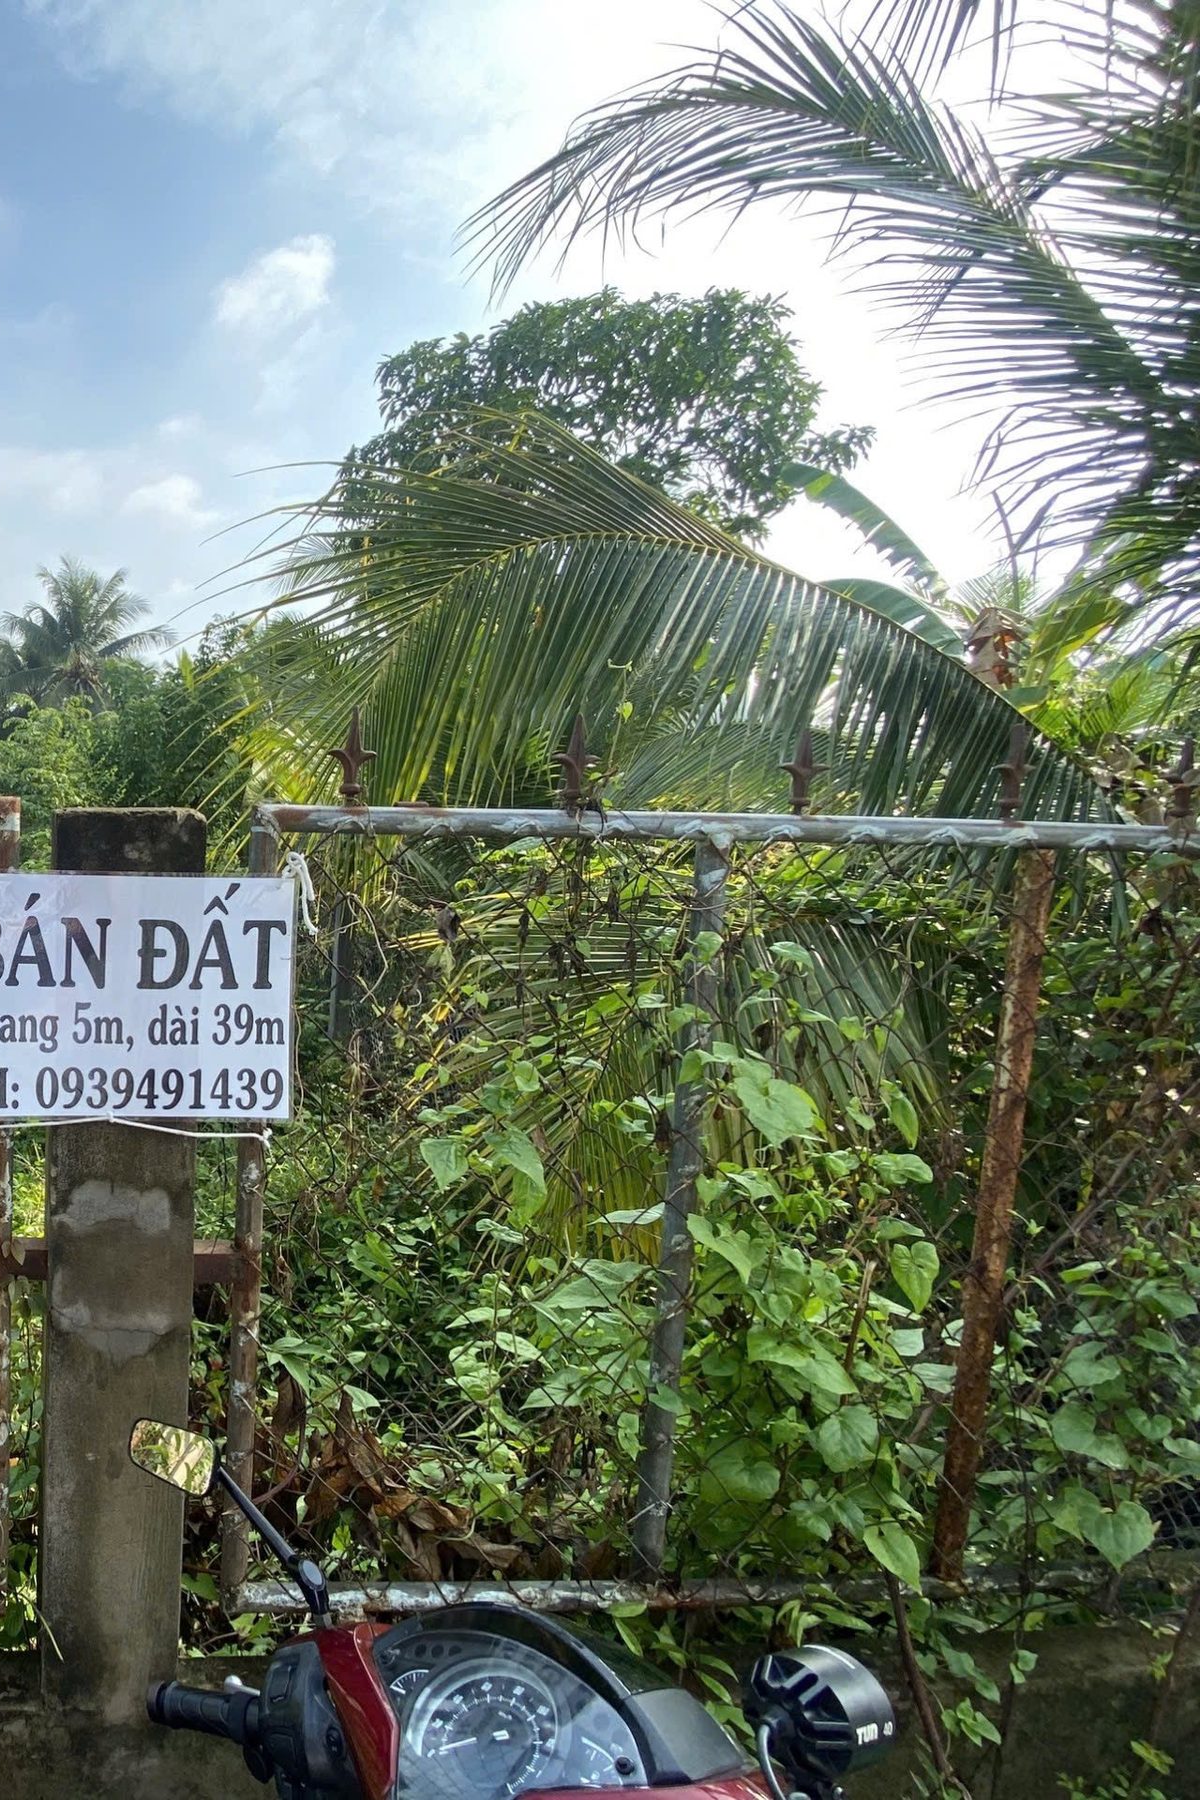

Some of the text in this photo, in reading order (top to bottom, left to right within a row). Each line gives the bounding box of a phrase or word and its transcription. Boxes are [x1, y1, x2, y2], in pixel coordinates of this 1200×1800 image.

[136, 882, 287, 991] ĐẤT
[72, 1002, 135, 1053] 5m,
[147, 1003, 200, 1046] dài
[212, 1003, 286, 1046] 39m
[35, 1066, 284, 1111] 0939491439
